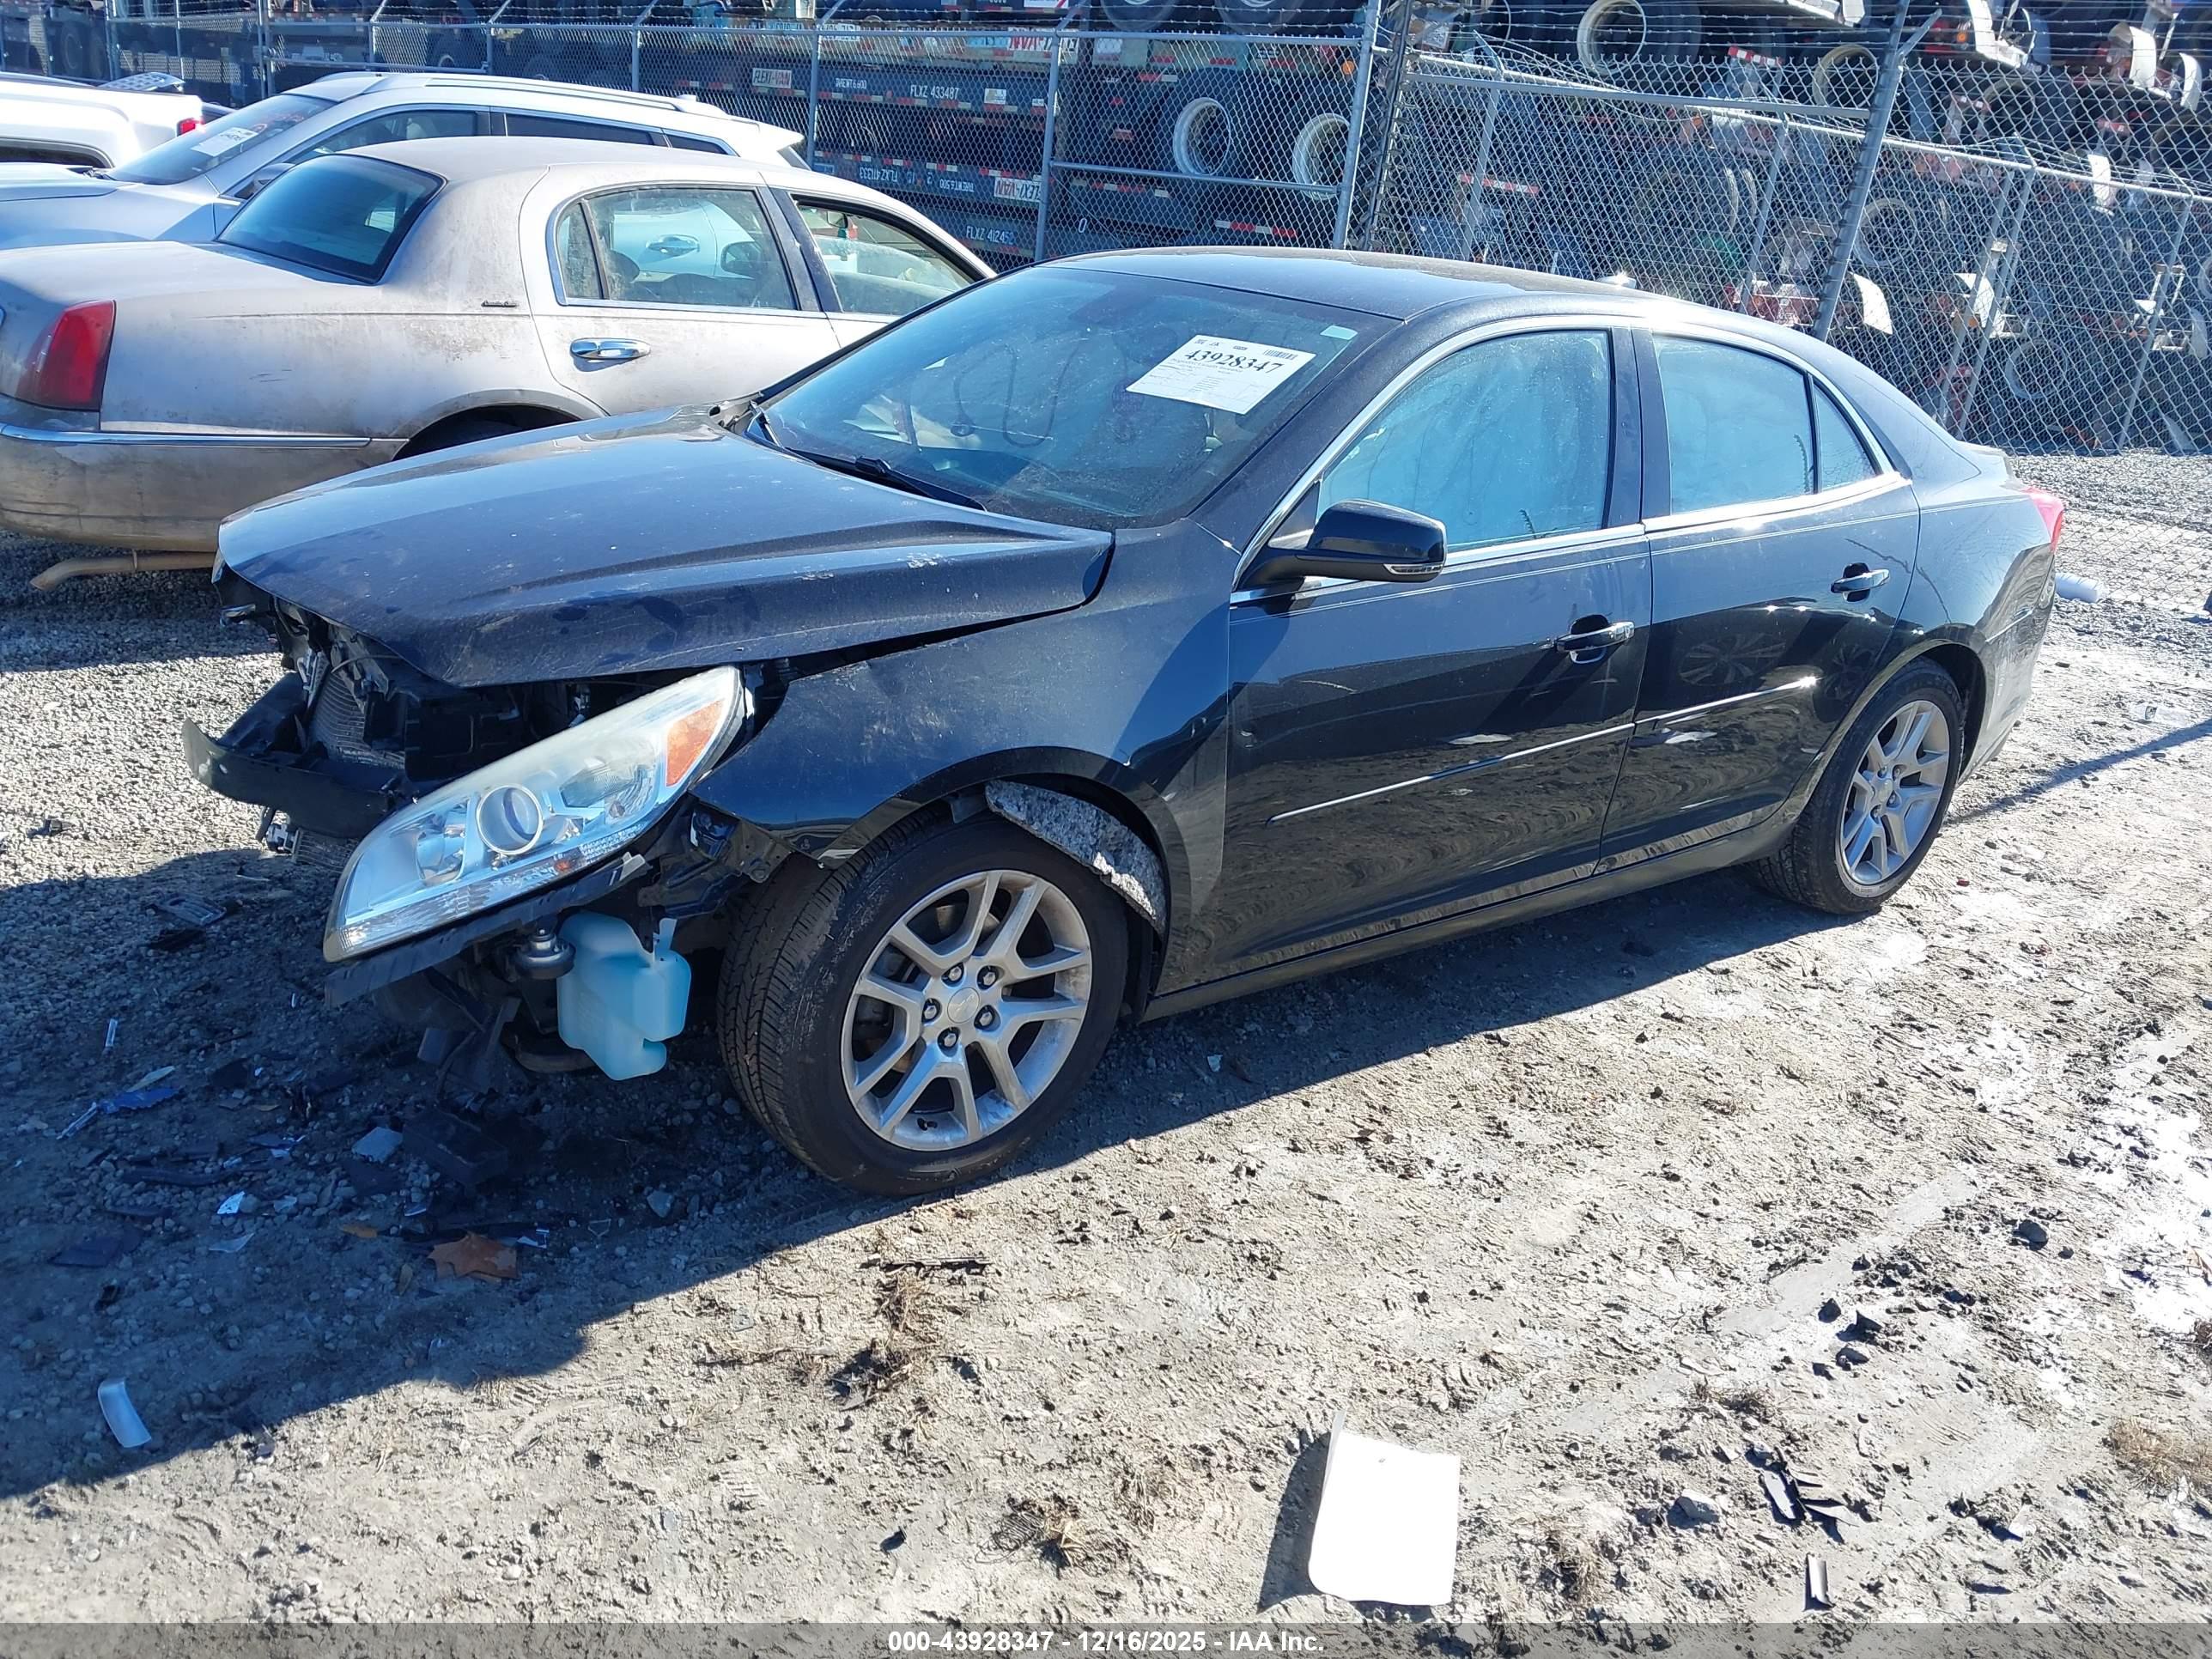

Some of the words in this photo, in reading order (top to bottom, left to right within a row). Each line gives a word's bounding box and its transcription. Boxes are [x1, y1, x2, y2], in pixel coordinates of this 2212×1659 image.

[910, 84, 928, 98] FLXZ
[930, 85, 960, 100] 433487
[966, 225, 985, 240] FLXZ
[1184, 349, 1285, 374] 43928347
